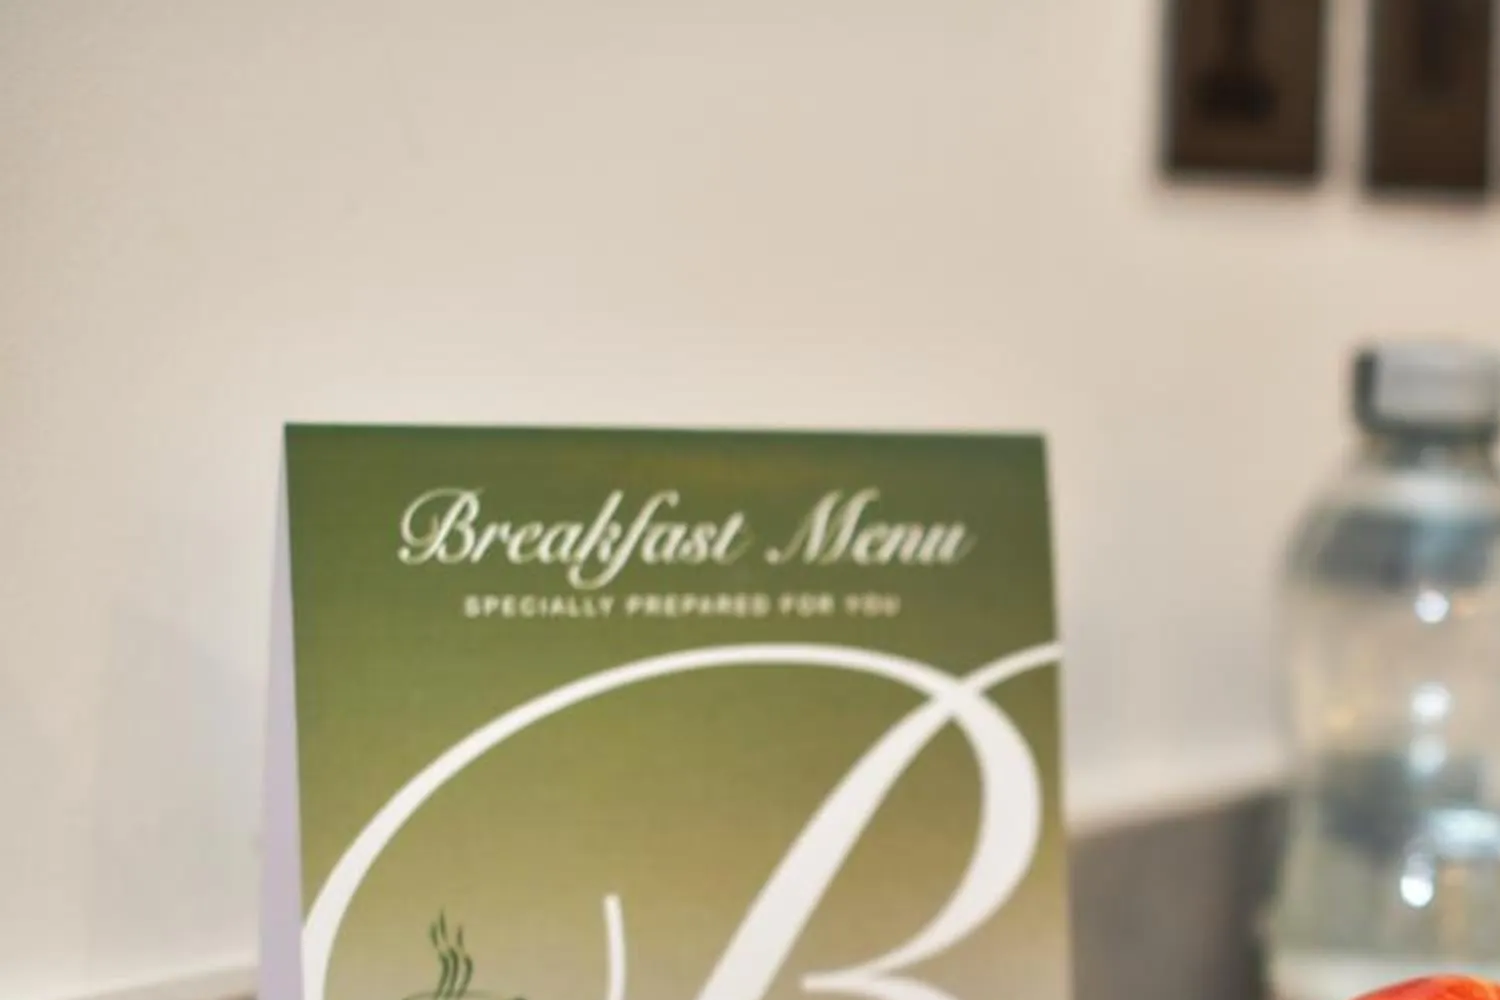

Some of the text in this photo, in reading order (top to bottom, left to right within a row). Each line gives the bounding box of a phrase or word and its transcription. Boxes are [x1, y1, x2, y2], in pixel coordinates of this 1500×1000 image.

[397, 486, 977, 590] Breakfast Menu
[463, 592, 901, 618] SPECIALLY PREPARED FOR YOU
